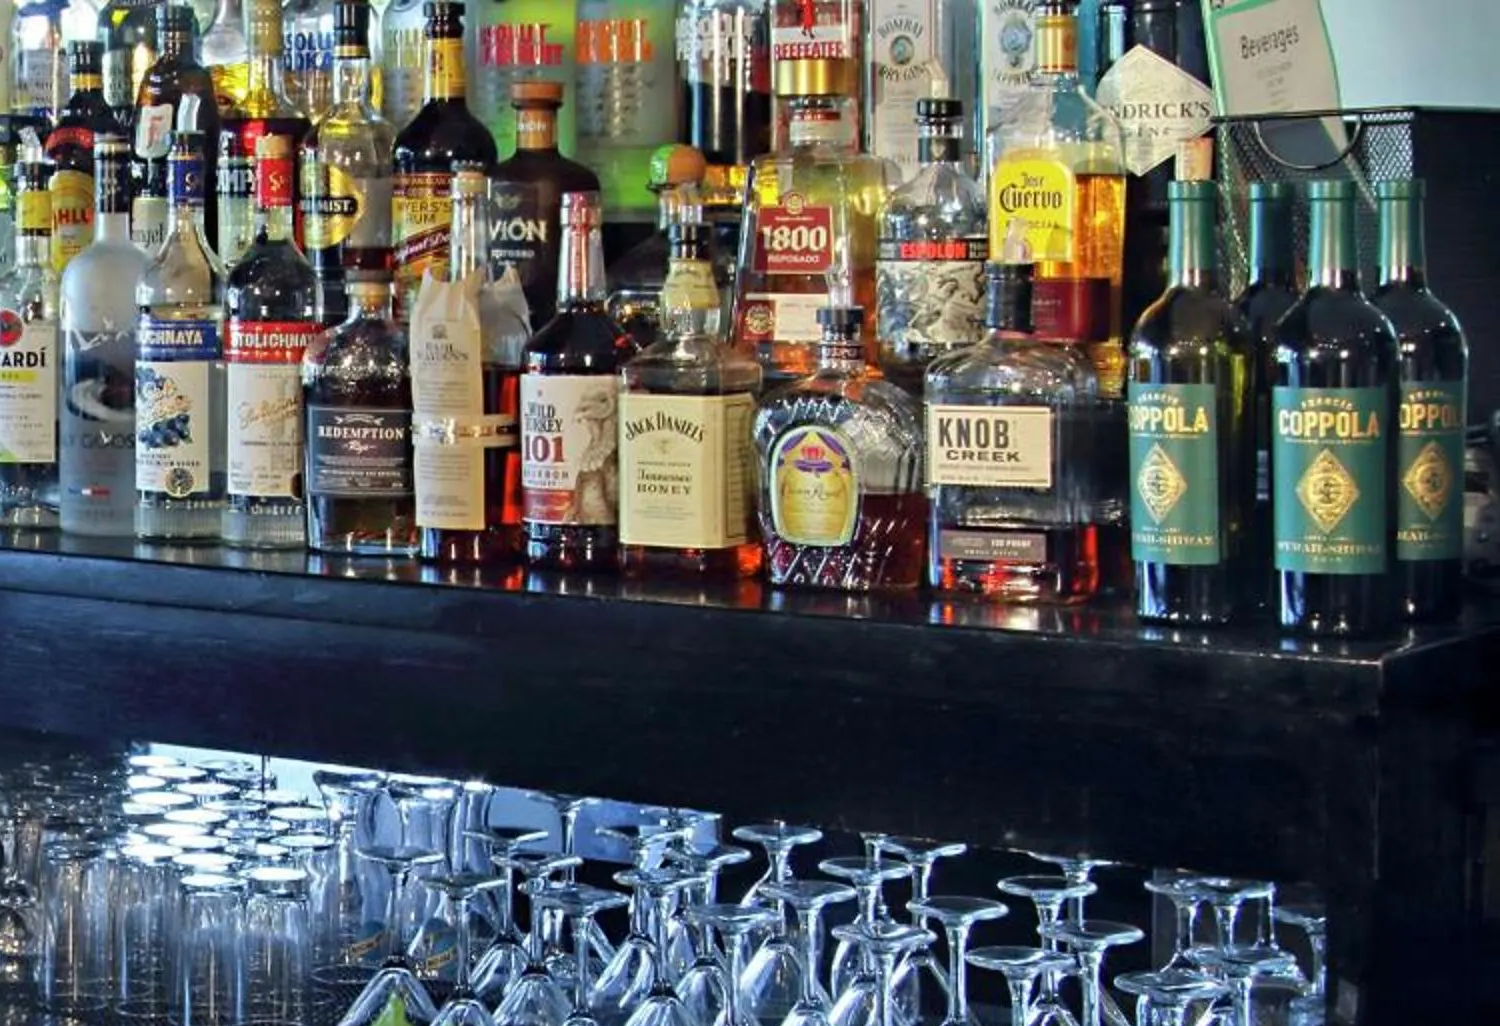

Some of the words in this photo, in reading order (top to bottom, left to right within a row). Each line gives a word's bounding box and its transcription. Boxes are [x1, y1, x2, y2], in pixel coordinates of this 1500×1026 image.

[284, 31, 333, 50] SOLU
[1239, 24, 1299, 60] Beverages
[1101, 101, 1211, 119] NDRICK'S
[999, 183, 1062, 213] Cuervo
[762, 225, 827, 251] 1800
[317, 425, 405, 441] REDEMPTION
[625, 415, 655, 441] JACK
[938, 417, 1009, 450] KNOB
[1278, 410, 1379, 439] COPPOLA
[524, 434, 565, 463] 101
[946, 450, 1021, 463] CREEK
[637, 483, 692, 495] HONEY
